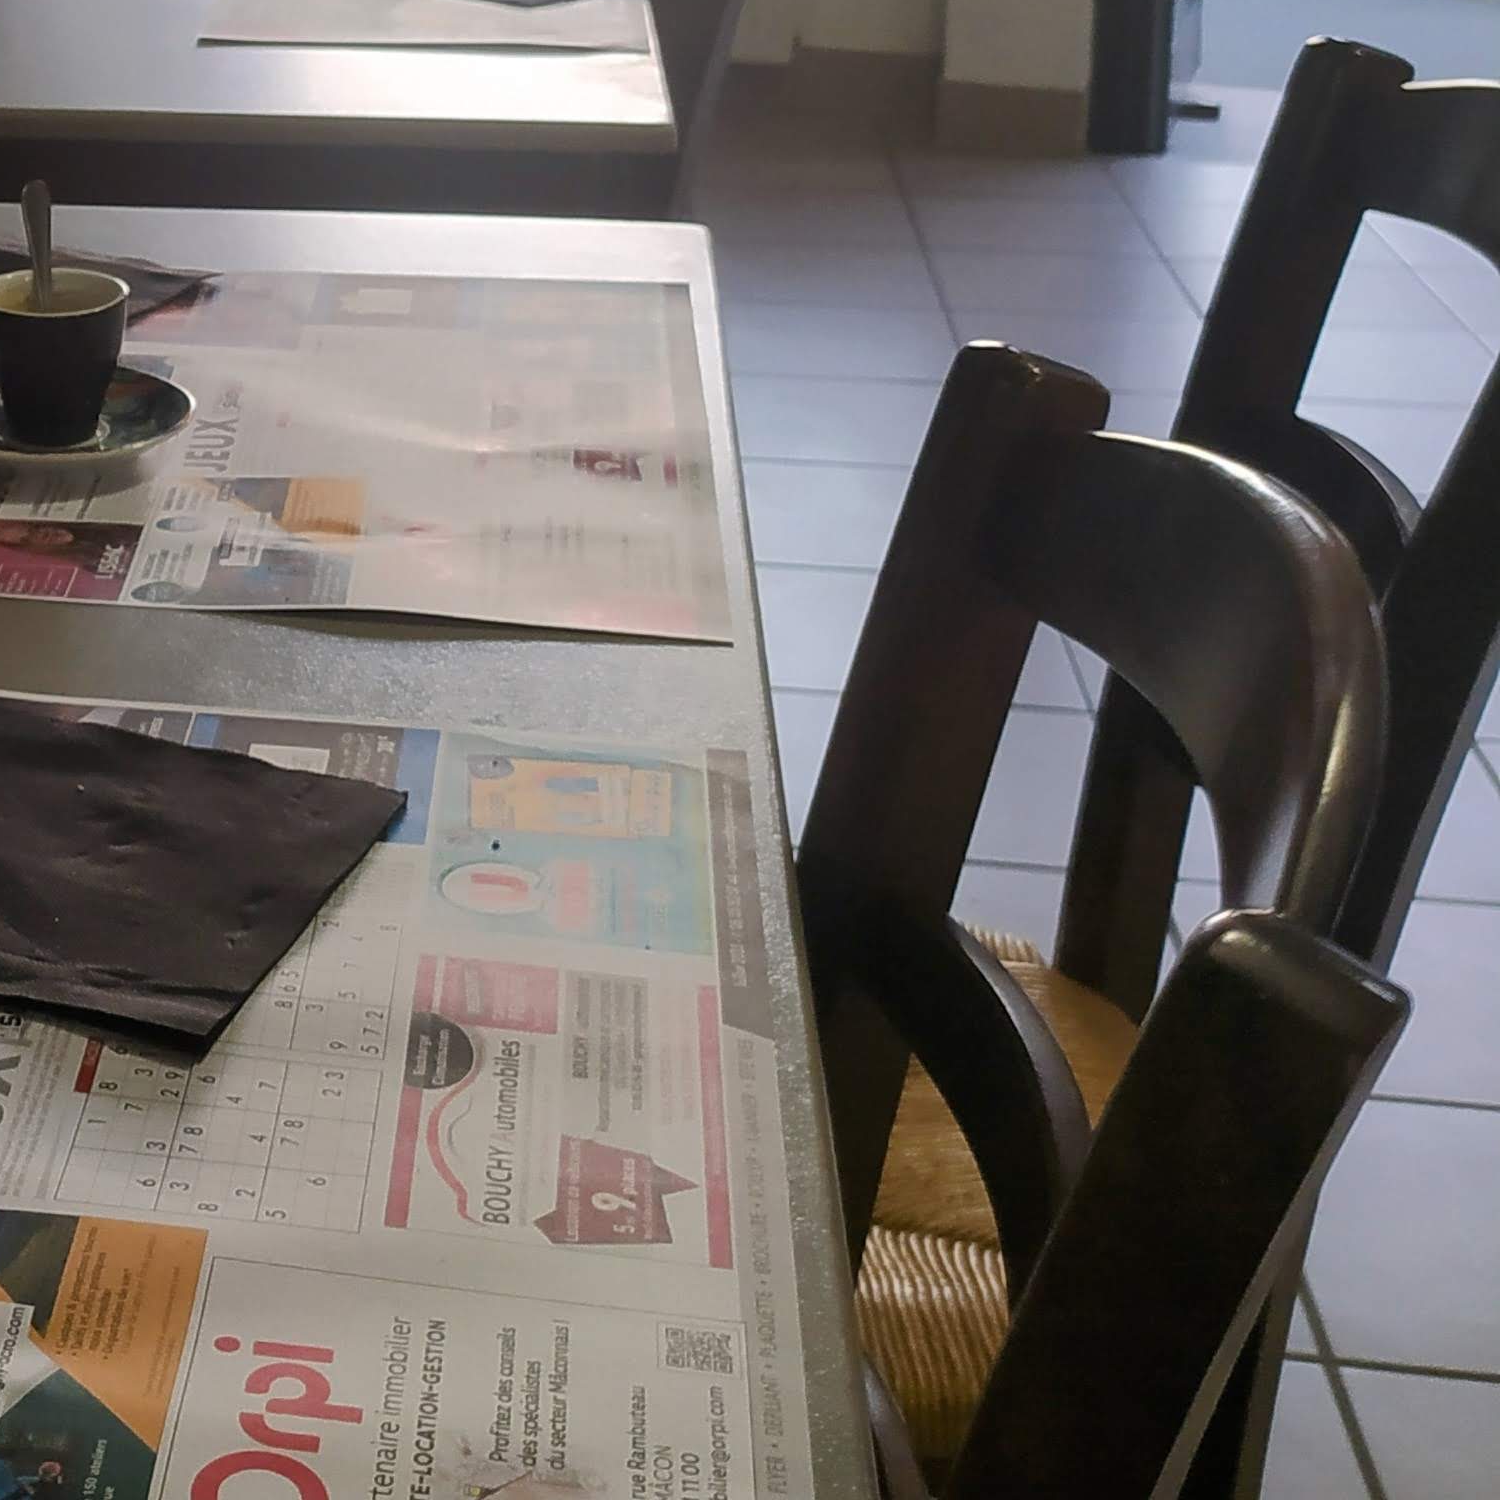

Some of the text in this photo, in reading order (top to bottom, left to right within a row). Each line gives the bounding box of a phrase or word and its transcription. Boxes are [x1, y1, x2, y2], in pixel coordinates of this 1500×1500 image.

[182, 418, 241, 477] JEUX
[328, 1041, 348, 1050] 9
[360, 1010, 385, 1054] 5 7 2
[161, 1089, 180, 1099] 2
[146, 1140, 166, 1152] 3
[183, 1126, 203, 1136] 8
[307, 1071, 344, 1187] 6 2 3
[481, 1039, 522, 1225] BOUCHY Automobiles
[178, 1144, 198, 1154] 7
[137, 1178, 156, 1187] 6
[170, 1181, 189, 1191] 3
[266, 1119, 303, 1219] 5 7 8
[198, 1203, 218, 1212] 8
[235, 1188, 255, 1198] 2
[591, 1191, 637, 1211] 9
[754, 1290, 778, 1357] PLAQUETTE
[374, 1315, 413, 1417] immobilier
[489, 1326, 519, 1463] Profitez des conseils
[518, 1360, 544, 1467] des spécialistes
[188, 1335, 365, 1500] Orpi
[547, 1397, 569, 1450] secteur
[545, 1451, 568, 1470] du
[627, 1385, 650, 1500] rue Rambuteau
[83, 1477, 98, 1495] 150
[765, 1455, 787, 1494] FLYER
